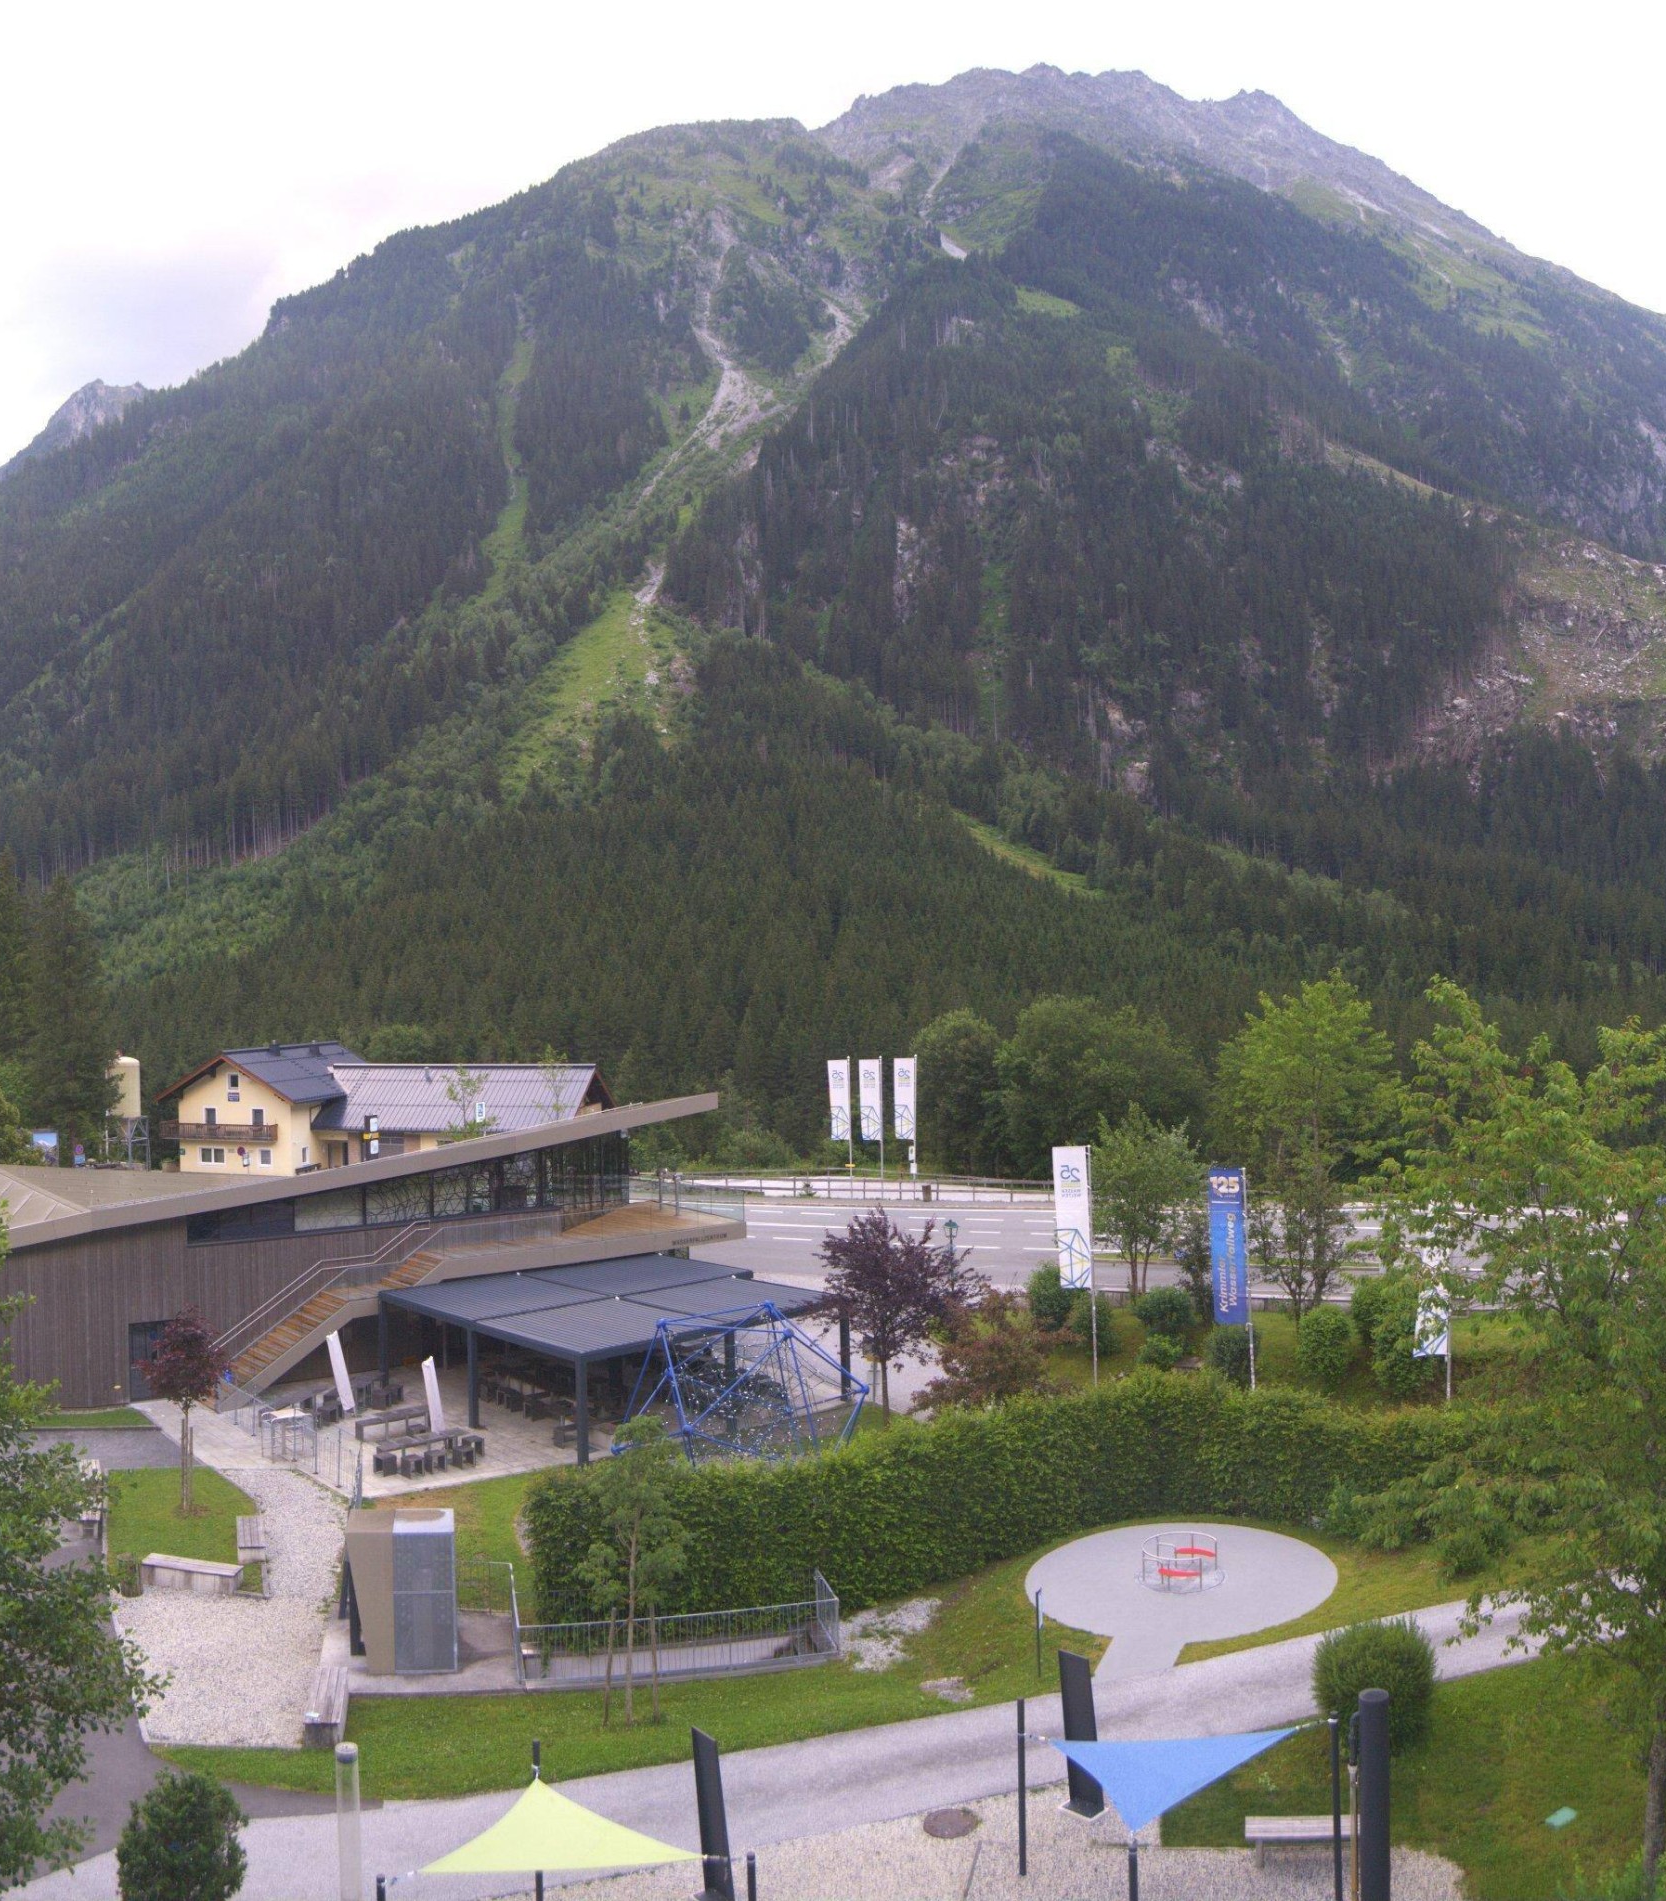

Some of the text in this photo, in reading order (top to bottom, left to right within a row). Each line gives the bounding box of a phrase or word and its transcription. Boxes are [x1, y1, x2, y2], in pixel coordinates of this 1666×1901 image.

[1210, 1176, 1240, 1195] 125
[1218, 1258, 1229, 1313] Krimmler
[1227, 1213, 1238, 1307] Wasserfallweg
